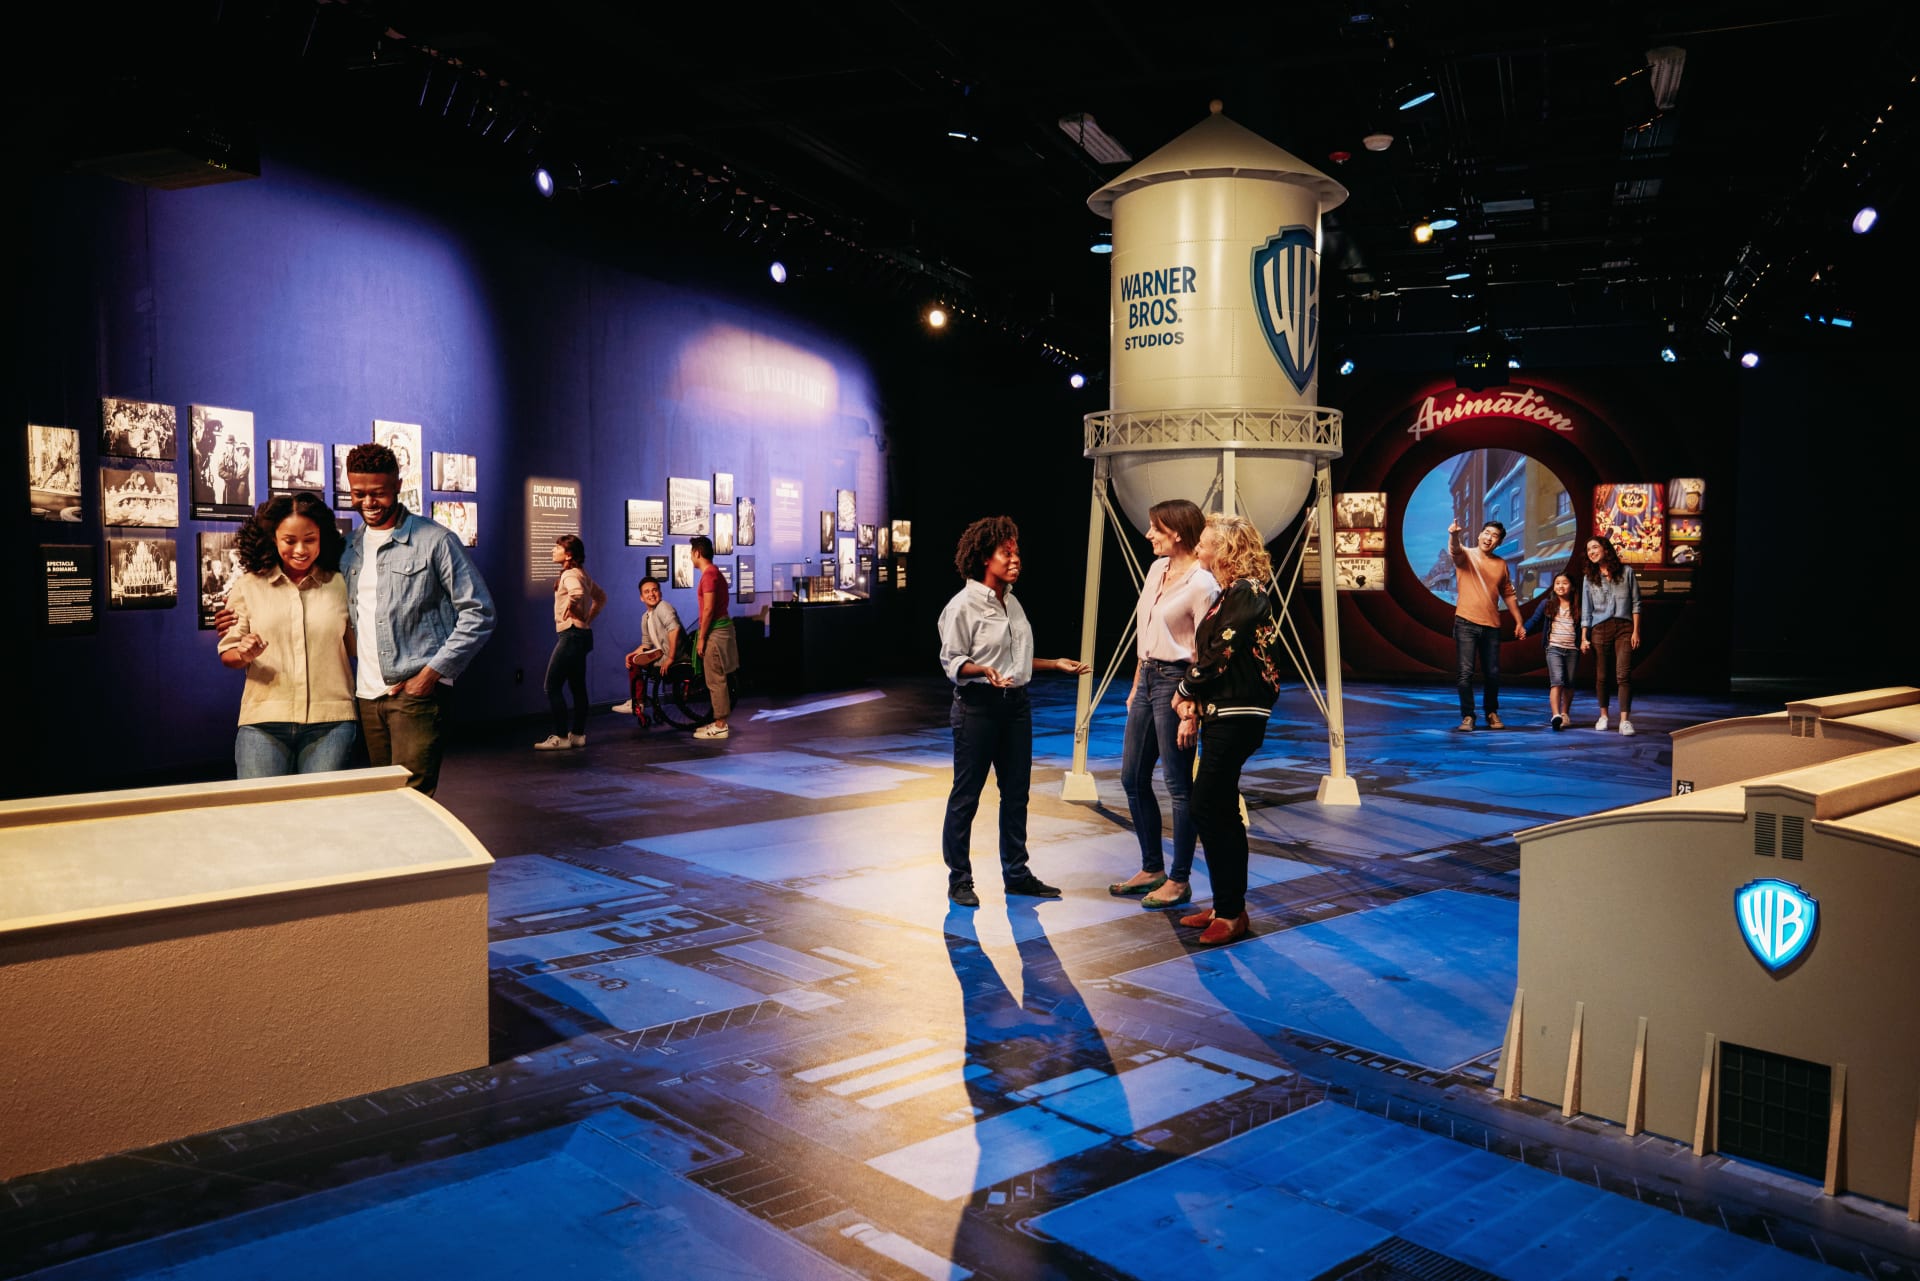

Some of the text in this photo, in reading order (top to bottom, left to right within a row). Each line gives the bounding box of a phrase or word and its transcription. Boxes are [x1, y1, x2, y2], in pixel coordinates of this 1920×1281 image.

[1121, 266, 1197, 302] WARNER
[1129, 298, 1183, 329] BROS.
[1262, 244, 1320, 374] WB
[1124, 331, 1185, 351] STUDIOS
[1407, 388, 1574, 441] Animation
[532, 494, 577, 510] ENLIGHTEN
[1743, 888, 1805, 959] WB
